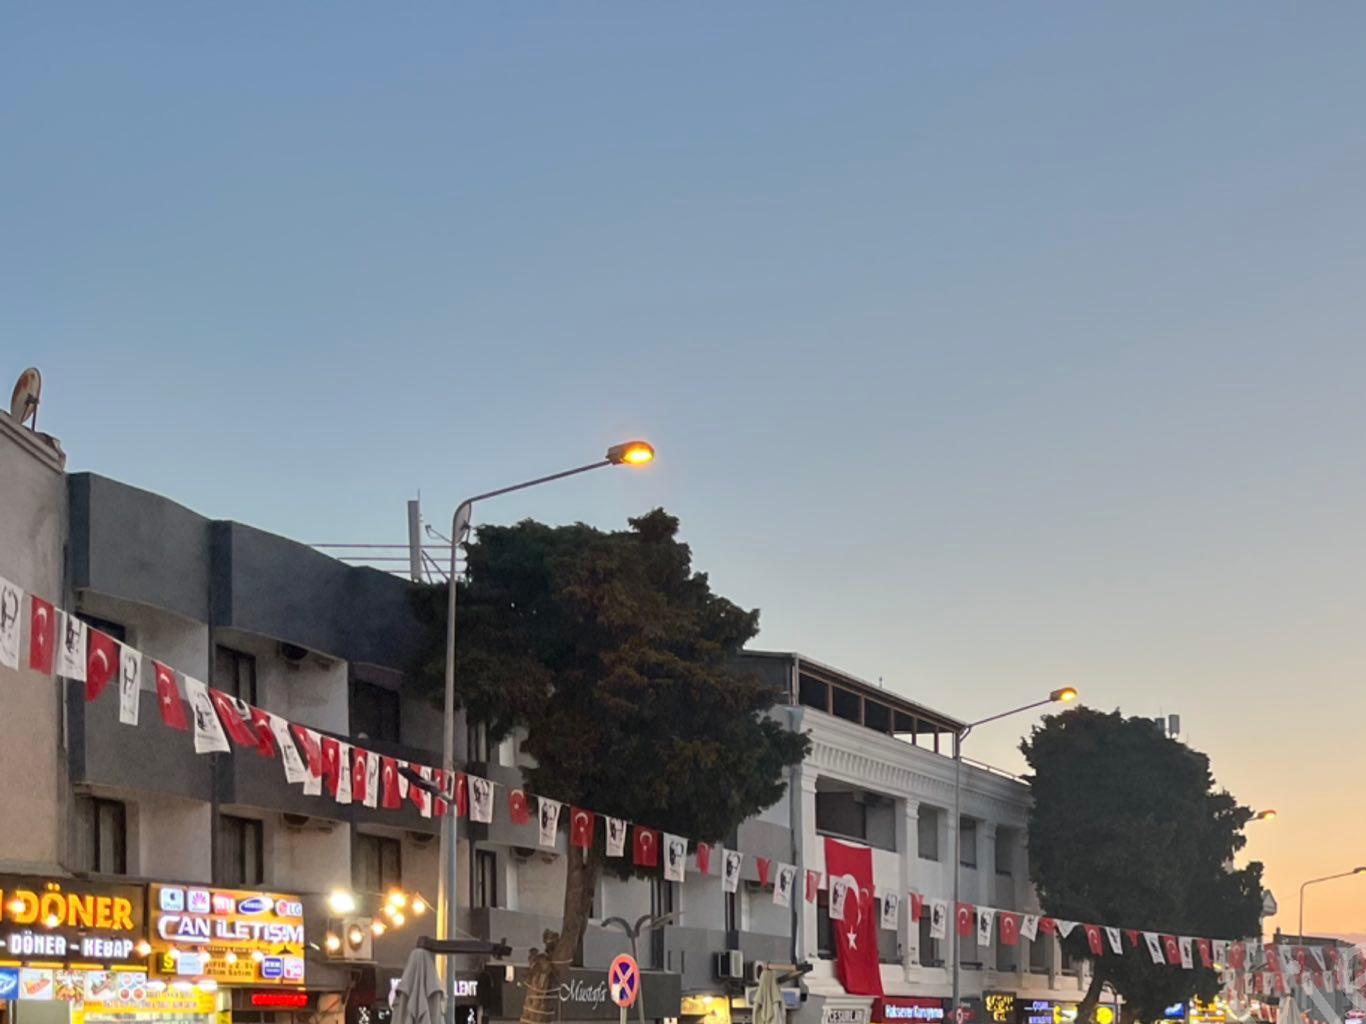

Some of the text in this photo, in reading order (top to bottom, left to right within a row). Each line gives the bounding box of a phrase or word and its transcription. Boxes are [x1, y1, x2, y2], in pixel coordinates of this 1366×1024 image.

[14, 882, 134, 930] DÖNER
[10, 929, 135, 959] DÖNER KEBAP
